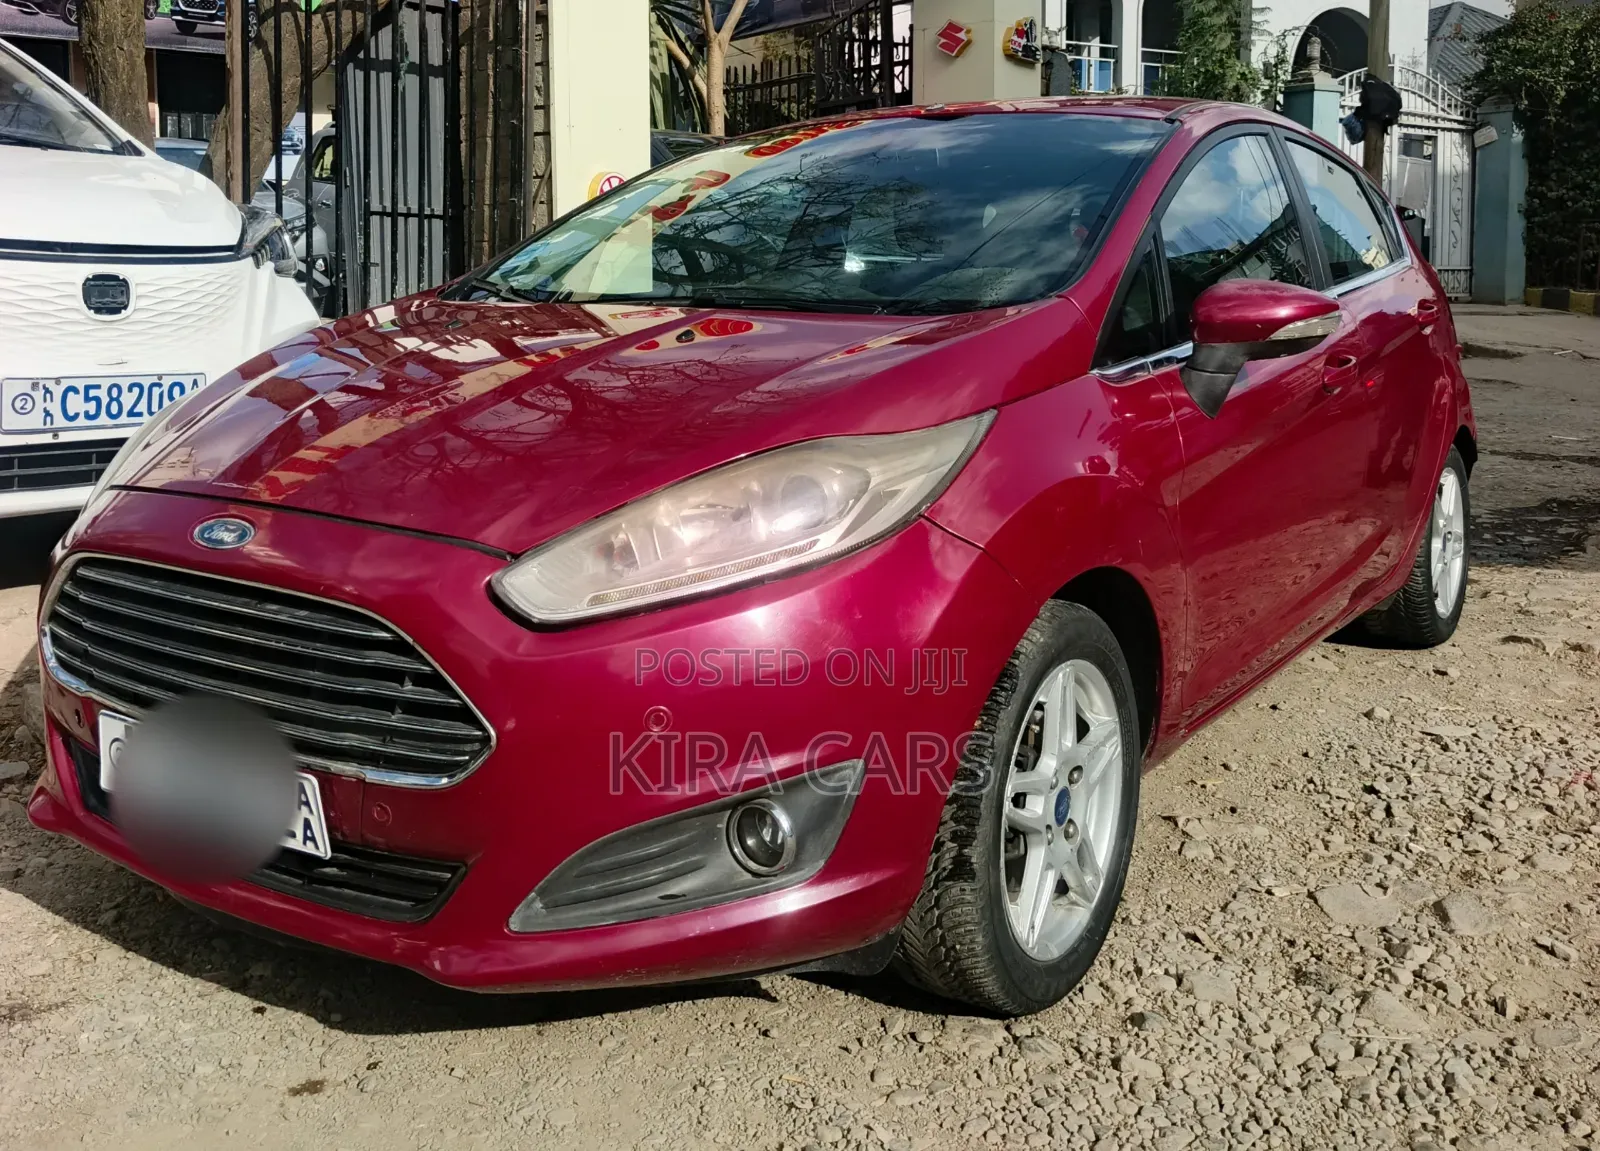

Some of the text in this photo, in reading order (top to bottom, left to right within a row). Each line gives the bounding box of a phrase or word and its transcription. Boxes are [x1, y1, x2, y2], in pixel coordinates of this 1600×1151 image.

[19, 398, 28, 411] 2
[203, 523, 242, 543] Ford
[303, 818, 320, 851] A
